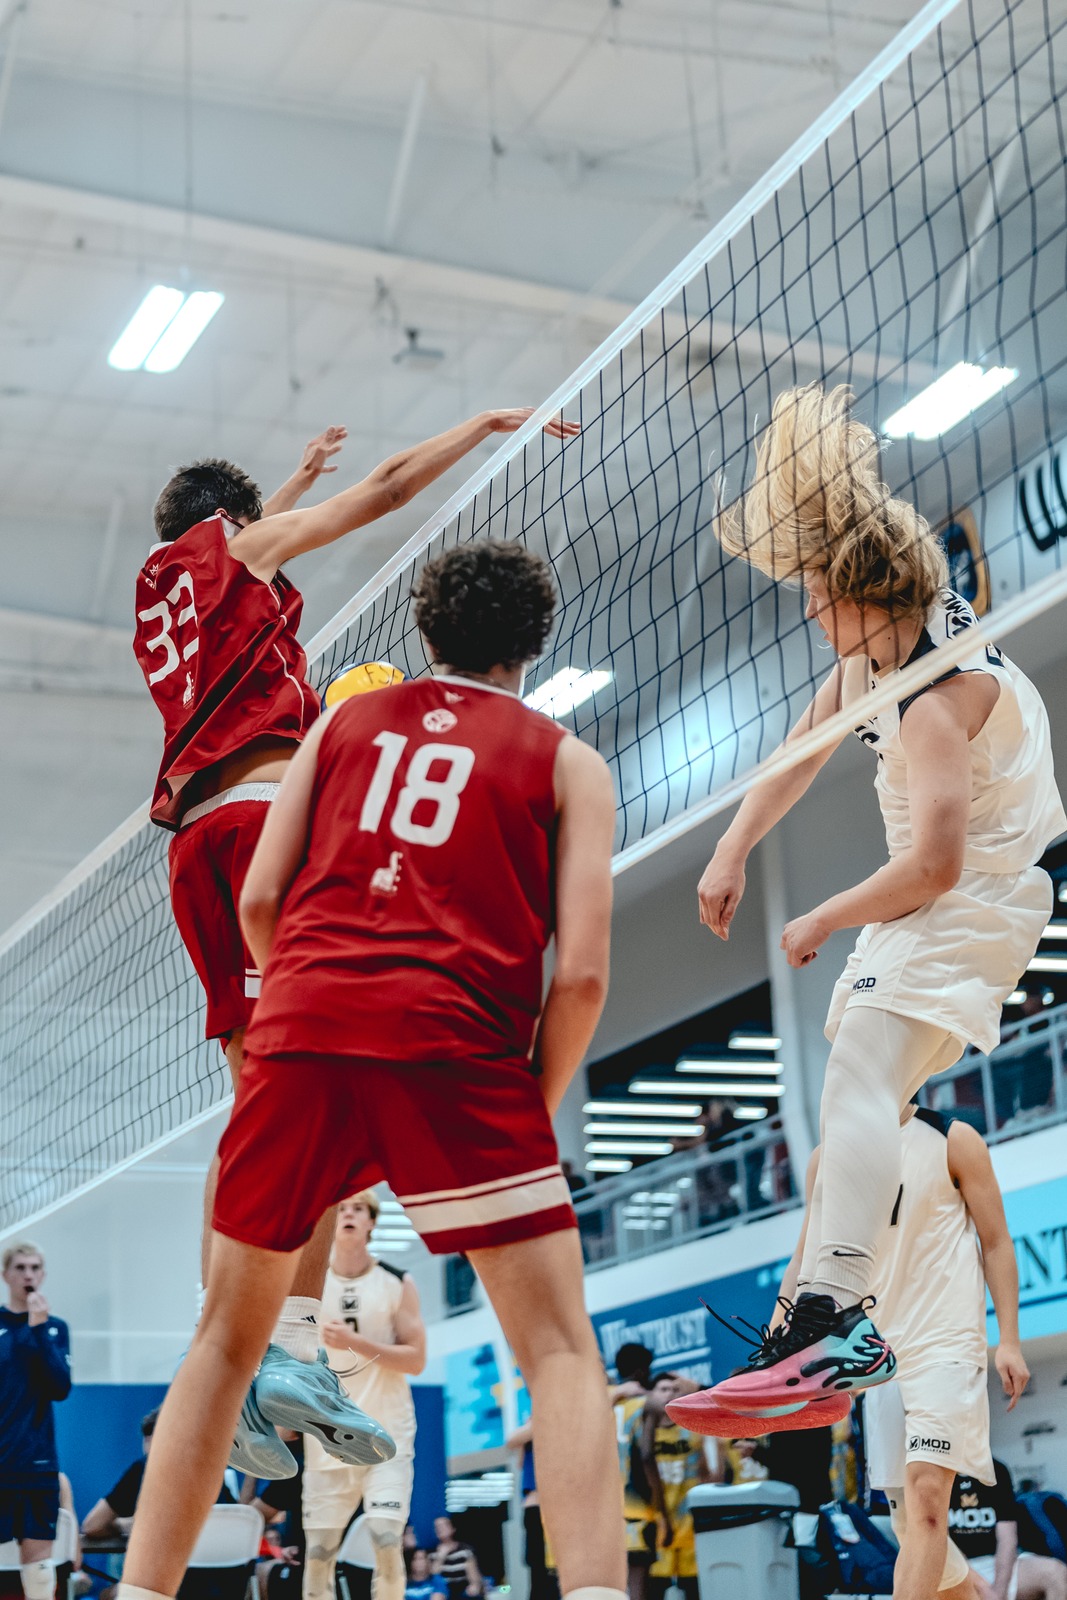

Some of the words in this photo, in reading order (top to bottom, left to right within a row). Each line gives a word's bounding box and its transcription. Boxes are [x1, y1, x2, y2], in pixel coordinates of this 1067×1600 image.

[359, 730, 476, 848] 18
[921, 1438, 951, 1450] MOD
[948, 1507, 996, 1528] MOD
